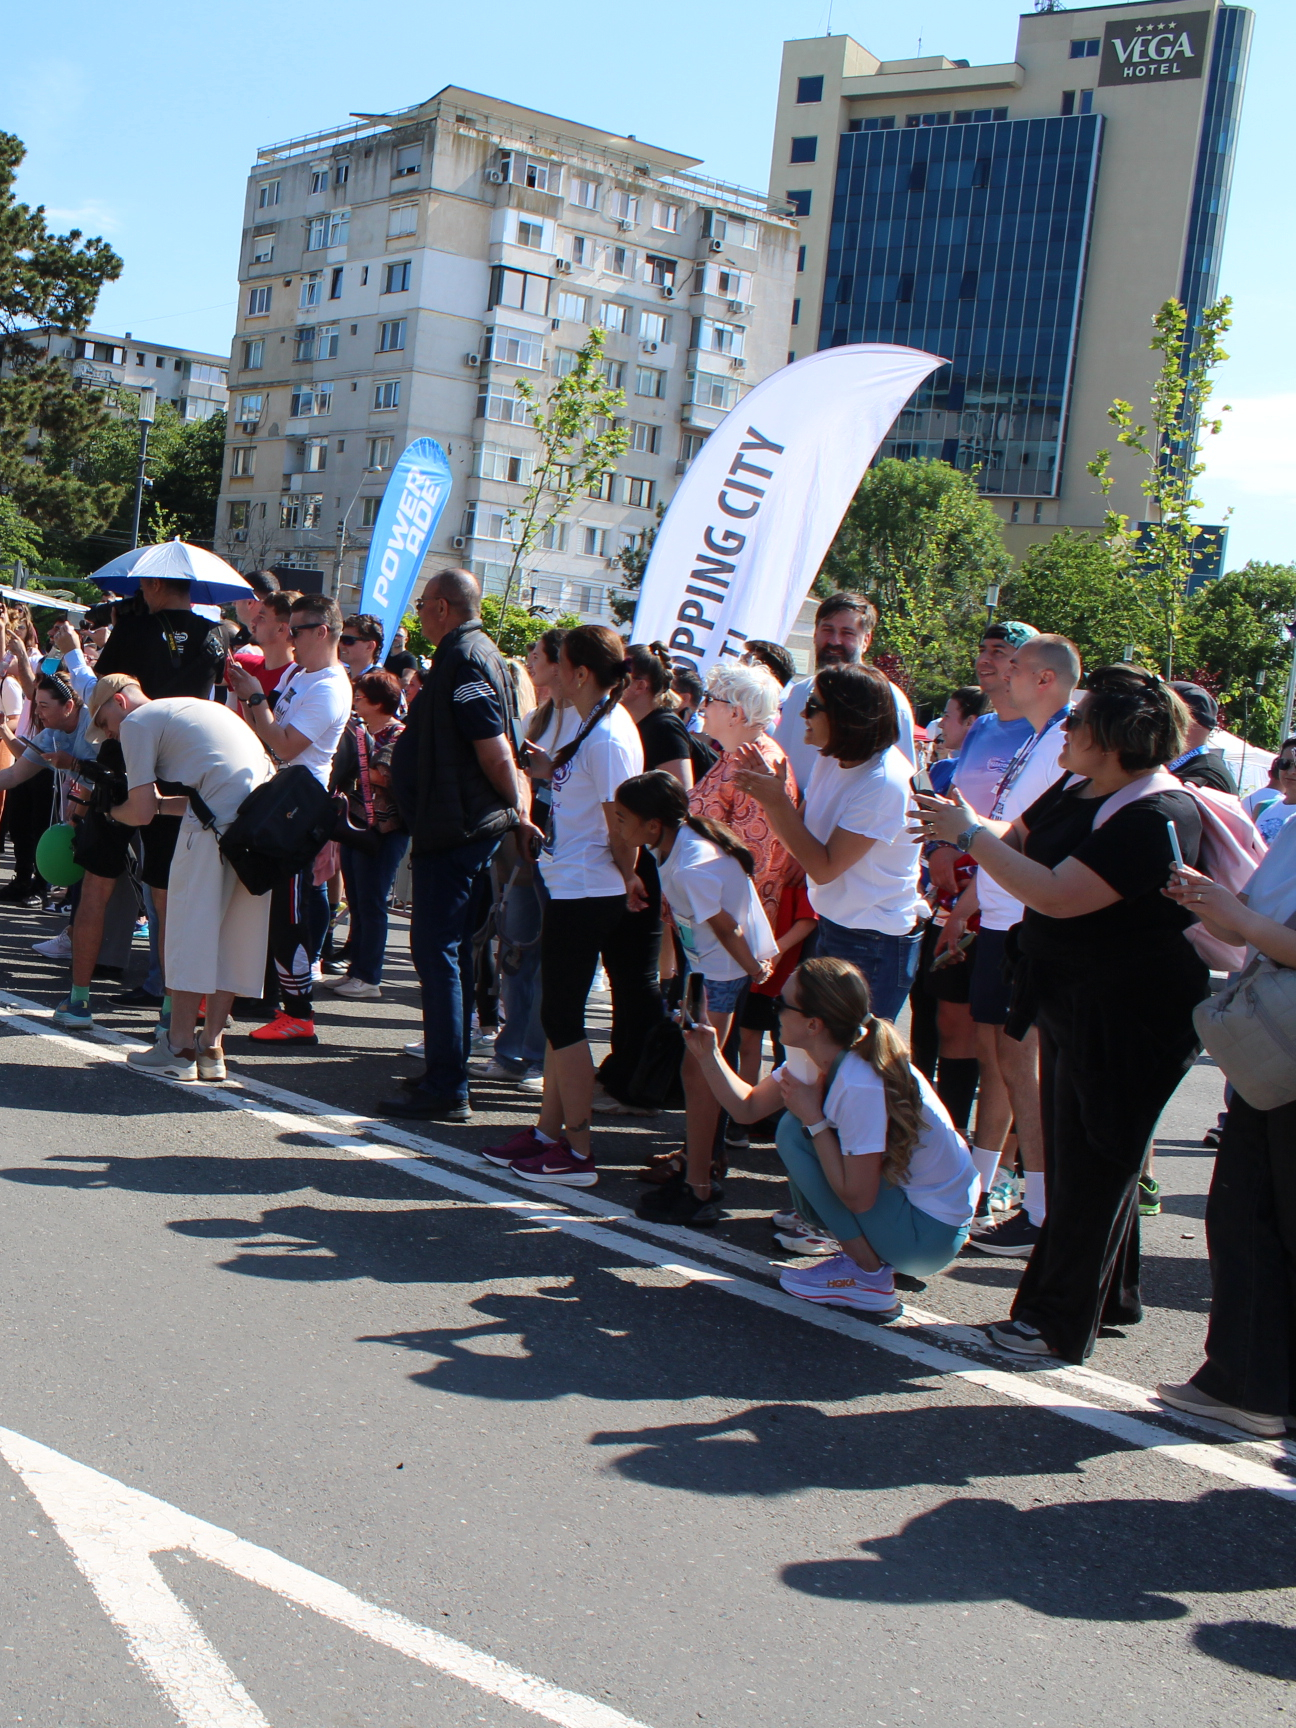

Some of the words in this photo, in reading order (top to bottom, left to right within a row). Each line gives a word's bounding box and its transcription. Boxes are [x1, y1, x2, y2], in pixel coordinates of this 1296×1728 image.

[1111, 31, 1195, 64] VEGA
[1123, 62, 1181, 78] HOTEL
[717, 425, 785, 520] CITY
[372, 466, 427, 609] POWER
[405, 477, 442, 558] ADE
[827, 1279, 856, 1288] HOKA
